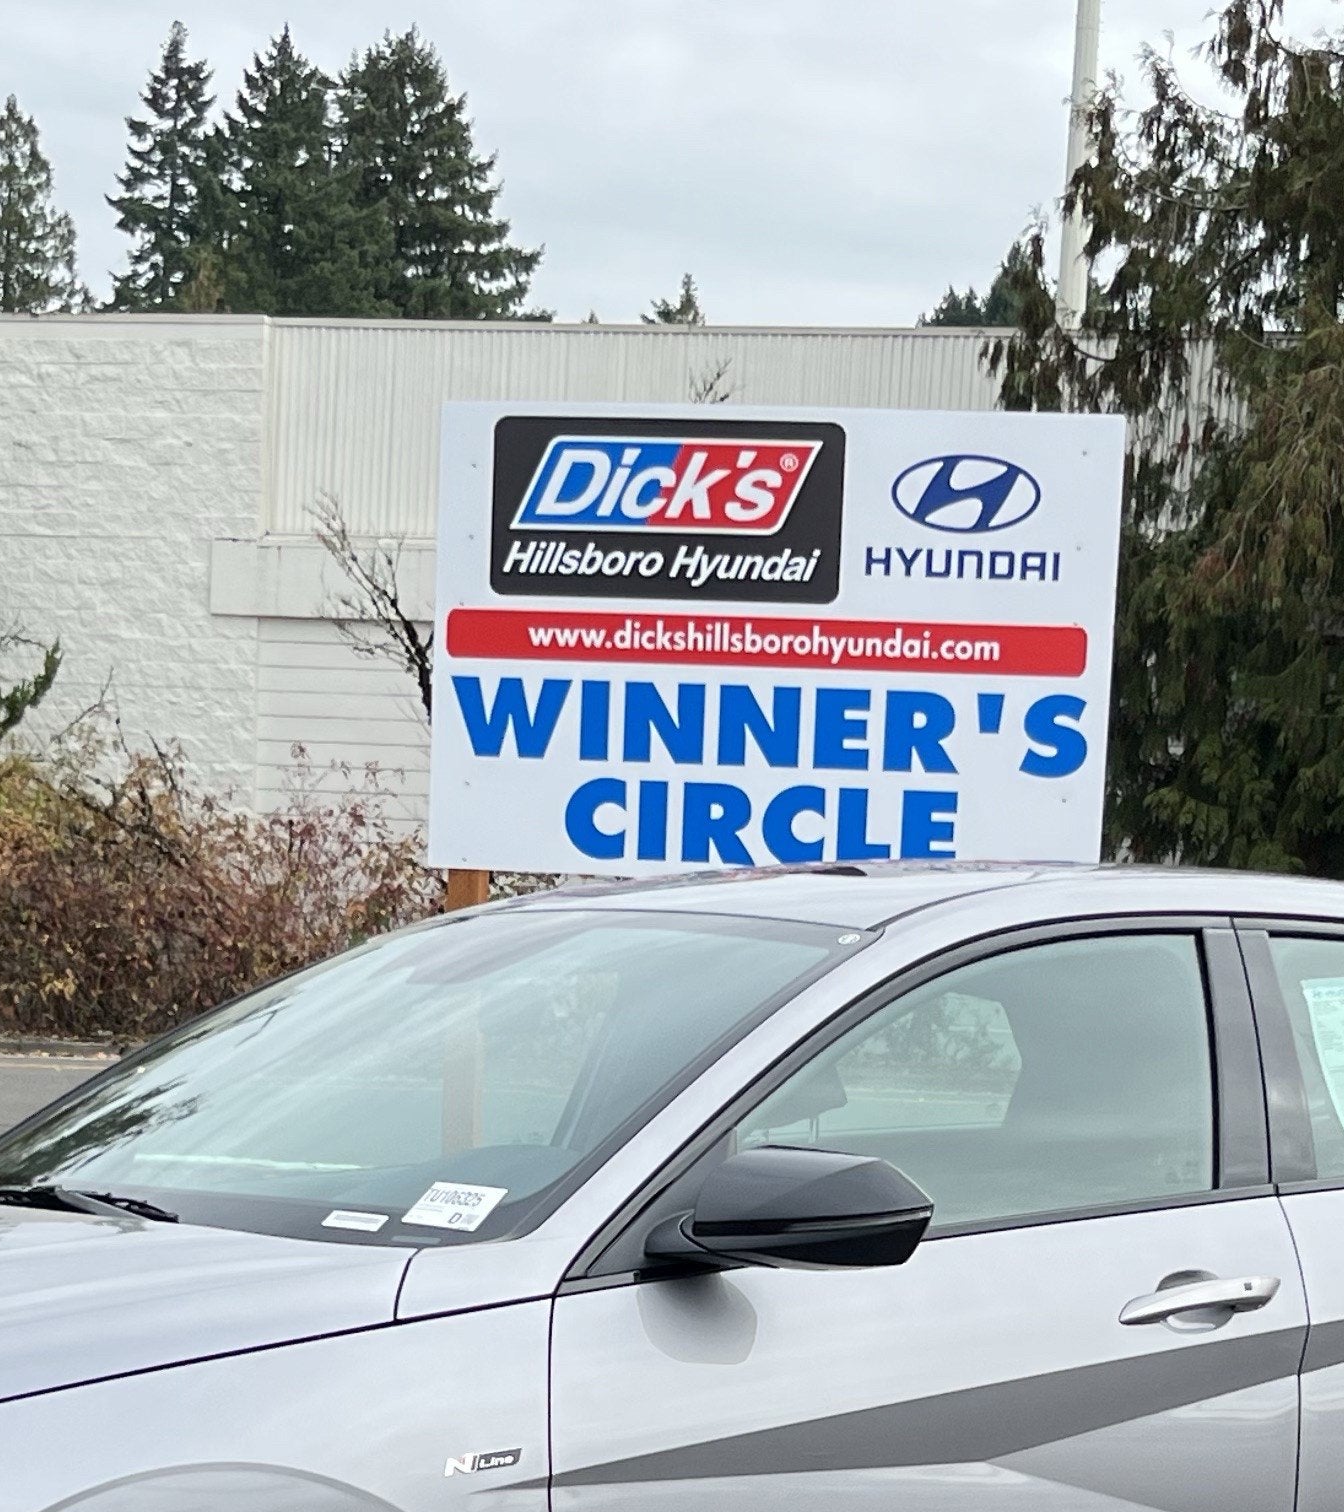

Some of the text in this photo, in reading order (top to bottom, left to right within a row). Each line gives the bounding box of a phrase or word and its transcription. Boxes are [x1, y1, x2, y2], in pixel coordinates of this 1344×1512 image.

[534, 447, 783, 521] Dick's
[502, 540, 821, 587] Hillsboro Hyundai
[865, 546, 1061, 581] HYUNDAI
[528, 619, 1000, 665] www.dickshillsborohyundai.com
[452, 674, 1088, 778] WINNER'S
[564, 776, 958, 866] CIRCLE
